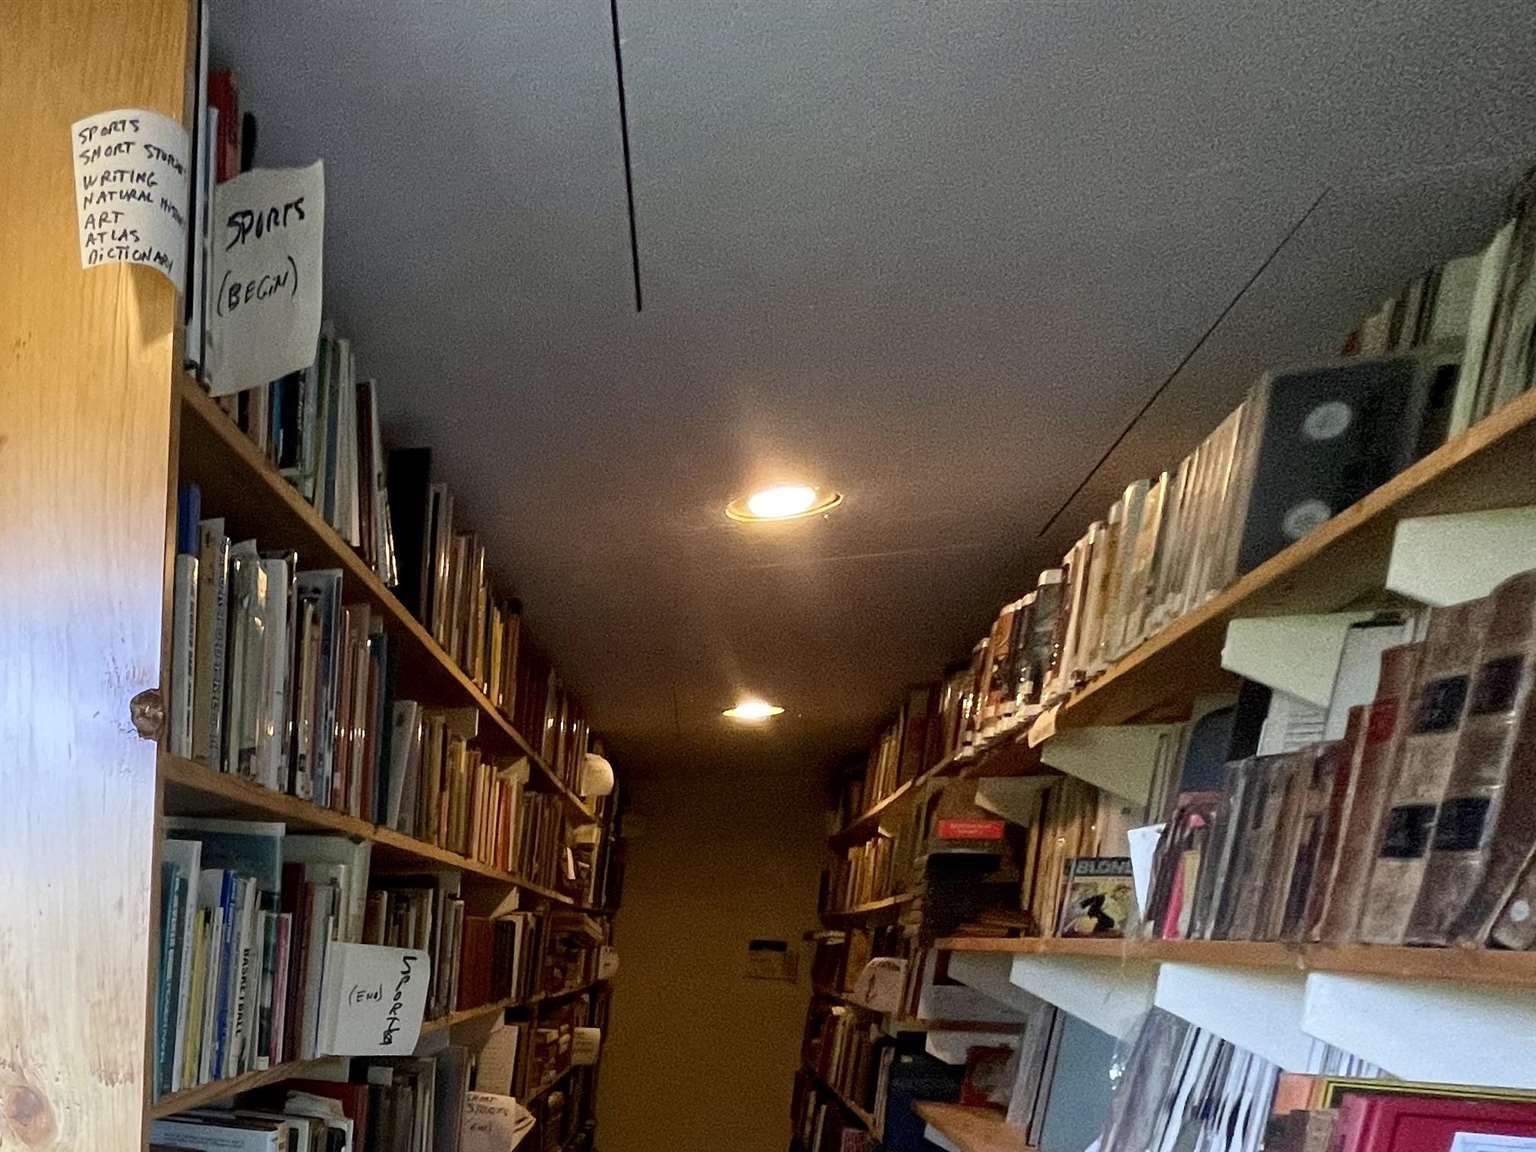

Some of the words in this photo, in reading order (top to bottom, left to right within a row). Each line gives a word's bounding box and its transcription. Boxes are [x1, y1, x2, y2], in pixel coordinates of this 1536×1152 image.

[78, 119, 140, 145] SPORTS
[79, 141, 136, 166] SHORT
[82, 169, 158, 190] WRITING
[83, 191, 154, 210] NATURAL
[84, 210, 124, 229] ART
[226, 197, 305, 250] SPORTS
[84, 228, 140, 248] ATLAS
[236, 948, 251, 1037] BASKETBALL
[349, 984, 383, 1007] (END)
